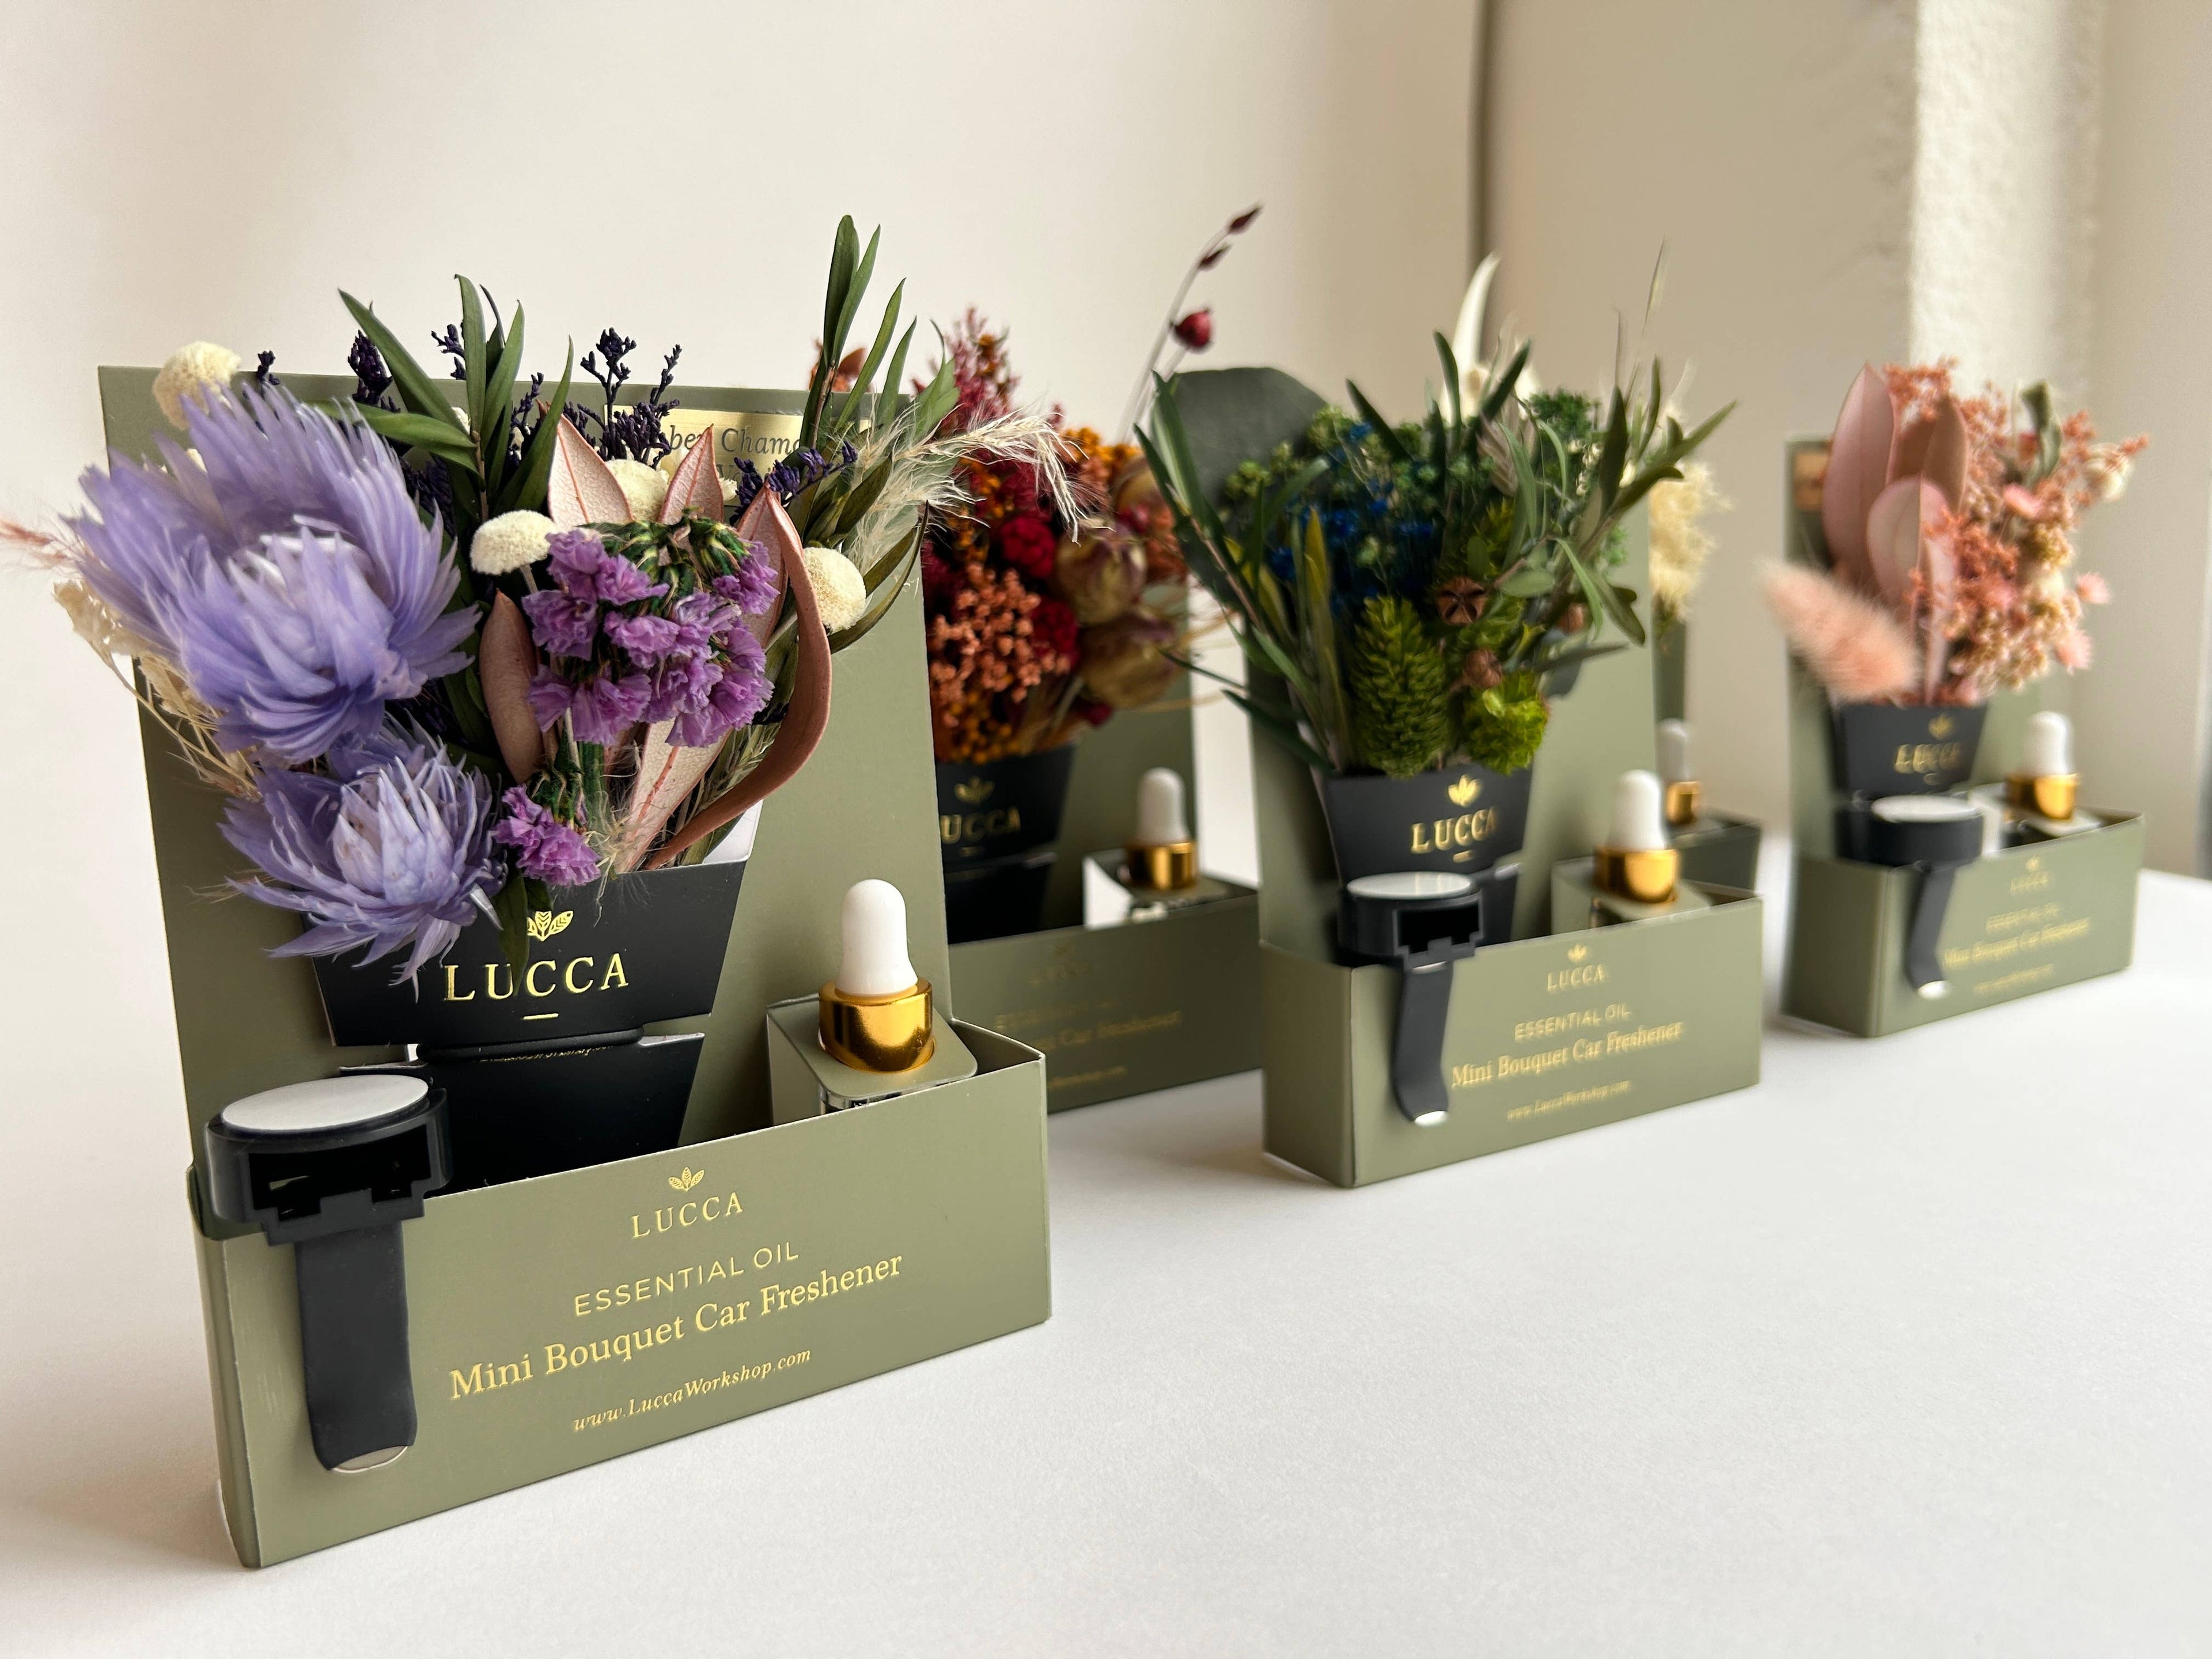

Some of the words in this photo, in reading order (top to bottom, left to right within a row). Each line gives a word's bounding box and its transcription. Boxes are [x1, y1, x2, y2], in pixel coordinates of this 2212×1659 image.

[1411, 806, 1498, 853] LUCCA
[444, 953, 629, 1001] LUCCA
[1547, 964, 1606, 993] LUCCA
[1514, 1008, 1601, 1043] ESSENTIAL
[1450, 1059, 1493, 1089] Mini
[1497, 1047, 1569, 1075] Bouquet
[1572, 1037, 1604, 1063] Car
[632, 1192, 743, 1238] LUCCA
[574, 1256, 744, 1316] ESSENTIAL
[752, 1241, 800, 1269] OIL
[450, 1354, 533, 1400] Mini
[544, 1315, 685, 1377] Bouquet
[695, 1297, 750, 1332] Car
[760, 1252, 903, 1316] Freshener
[573, 1347, 812, 1433] www.LuccaWorkshop.com
